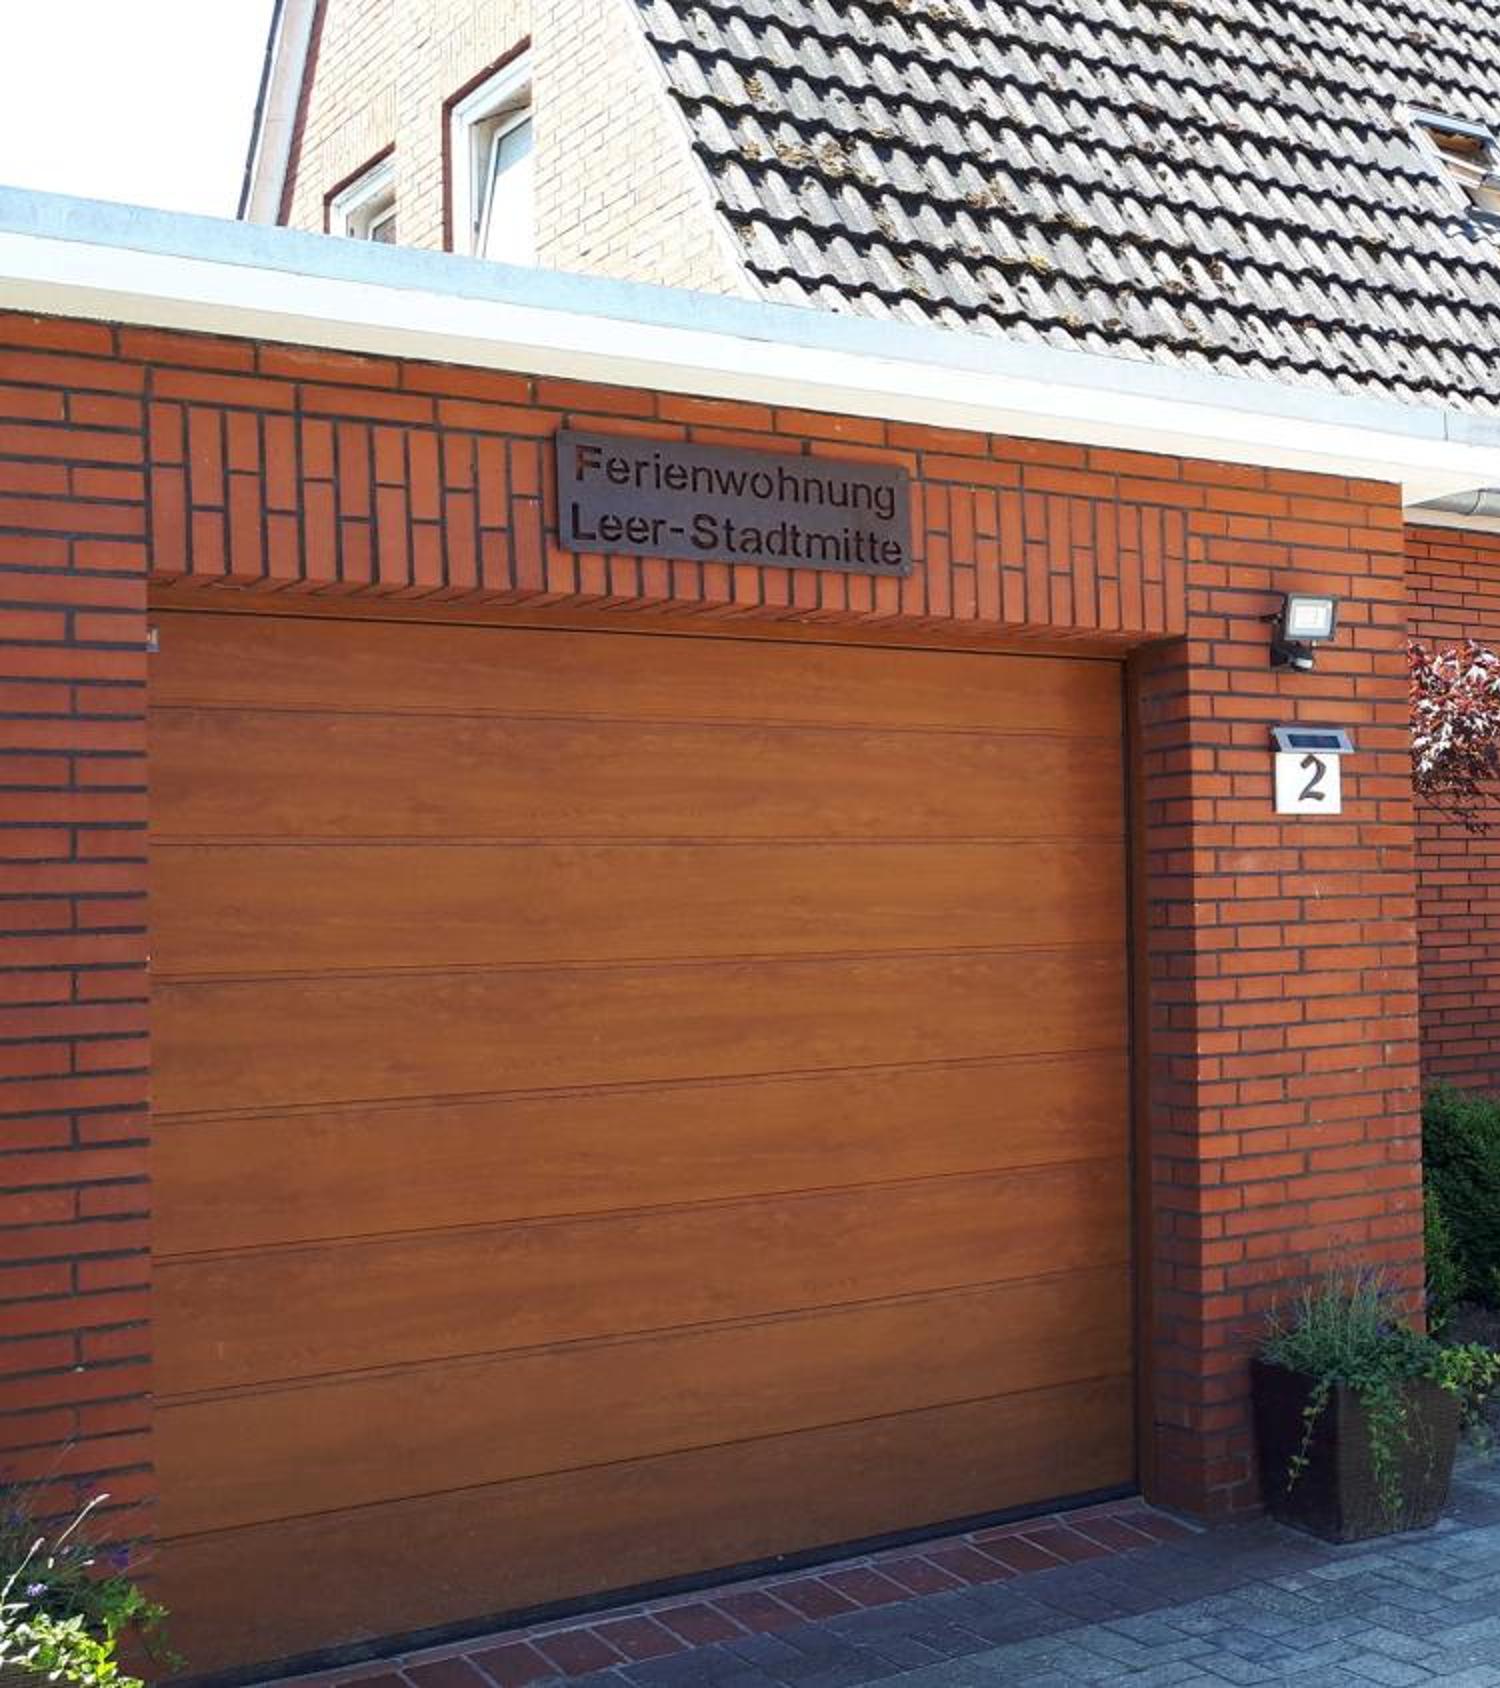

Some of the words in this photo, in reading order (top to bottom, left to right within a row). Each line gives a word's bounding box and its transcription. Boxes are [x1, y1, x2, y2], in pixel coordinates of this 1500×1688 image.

[575, 444, 896, 521] Ferienwohnung
[571, 502, 903, 566] Leer-Stadtmitte
[1298, 753, 1327, 801] 2
